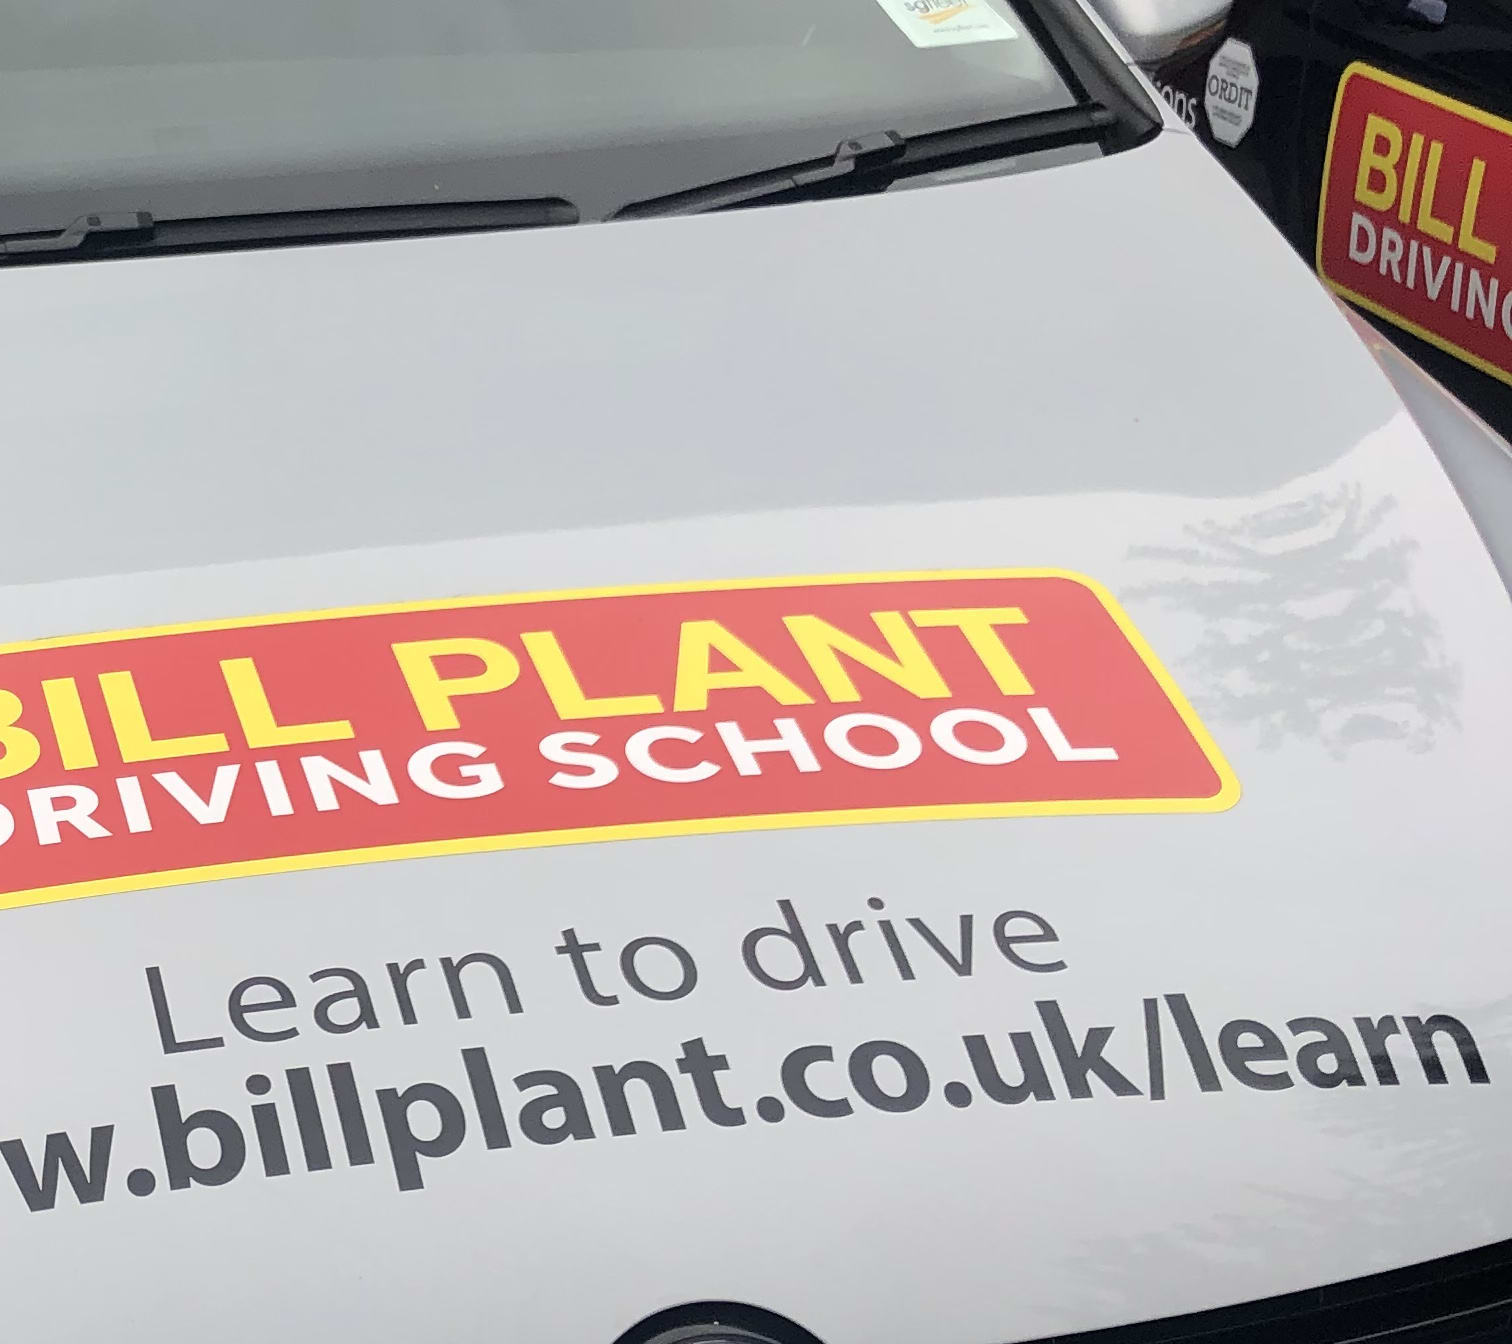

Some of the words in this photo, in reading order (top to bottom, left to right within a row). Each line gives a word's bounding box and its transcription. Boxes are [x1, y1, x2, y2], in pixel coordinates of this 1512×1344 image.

[1208, 74, 1253, 111] ORDIT
[1354, 112, 1497, 265] BILL
[390, 607, 1034, 731] PLANT
[538, 707, 1120, 789] SCHOOL
[144, 959, 524, 1056] Learn
[554, 927, 698, 1007] to
[741, 899, 1068, 992] drive
